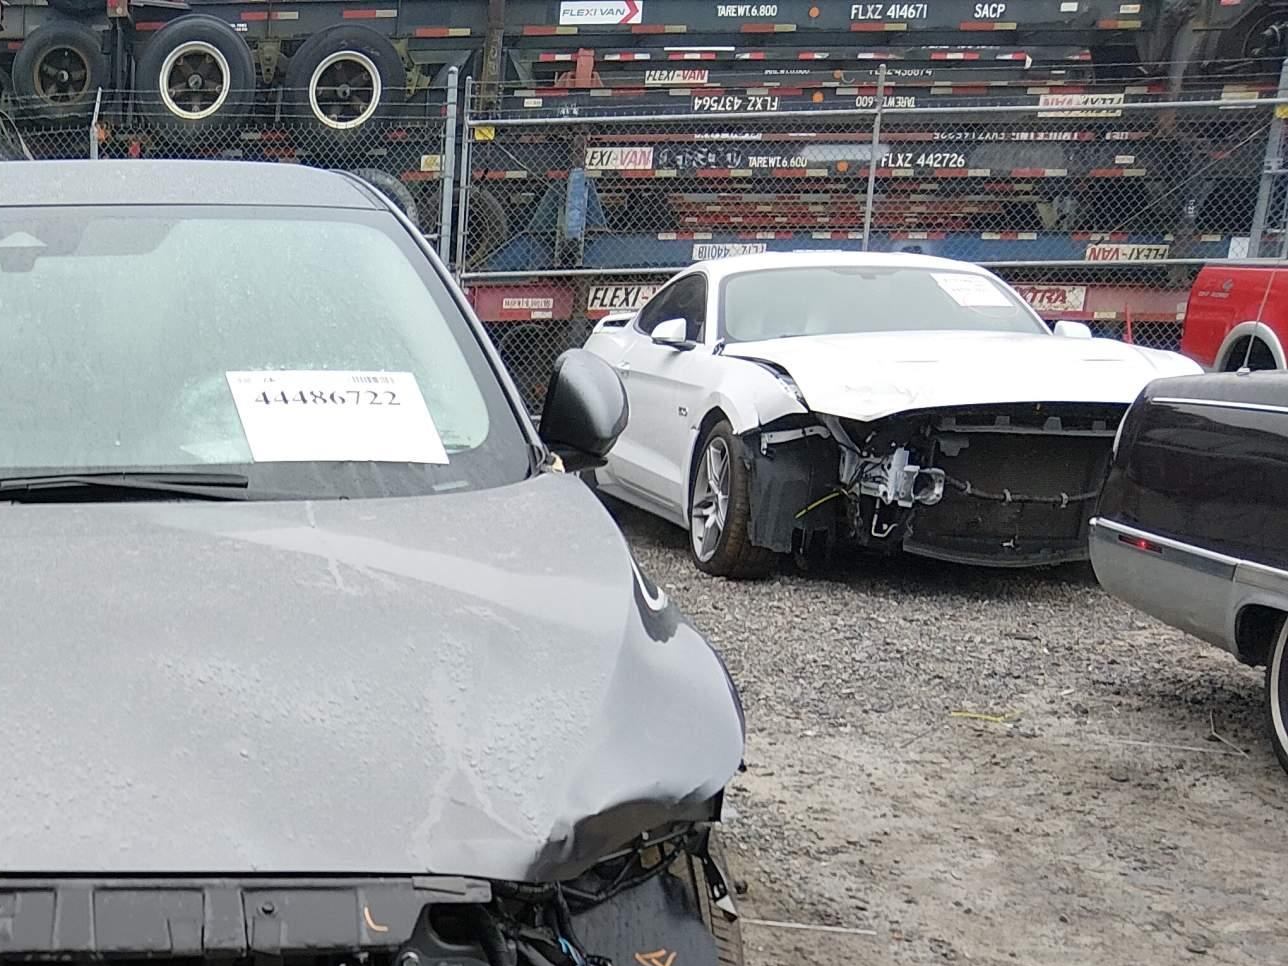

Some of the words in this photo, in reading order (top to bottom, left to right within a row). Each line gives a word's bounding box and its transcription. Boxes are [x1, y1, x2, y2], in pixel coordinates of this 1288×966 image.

[850, 4, 883, 19] FLXZ
[886, 4, 928, 19] 414671
[974, 3, 1006, 18] SACP
[694, 97, 743, 111] 437564
[747, 96, 779, 110] FLXZ
[881, 153, 912, 167] FLXZ
[916, 153, 966, 167] 442726
[254, 390, 401, 405] 44486722
